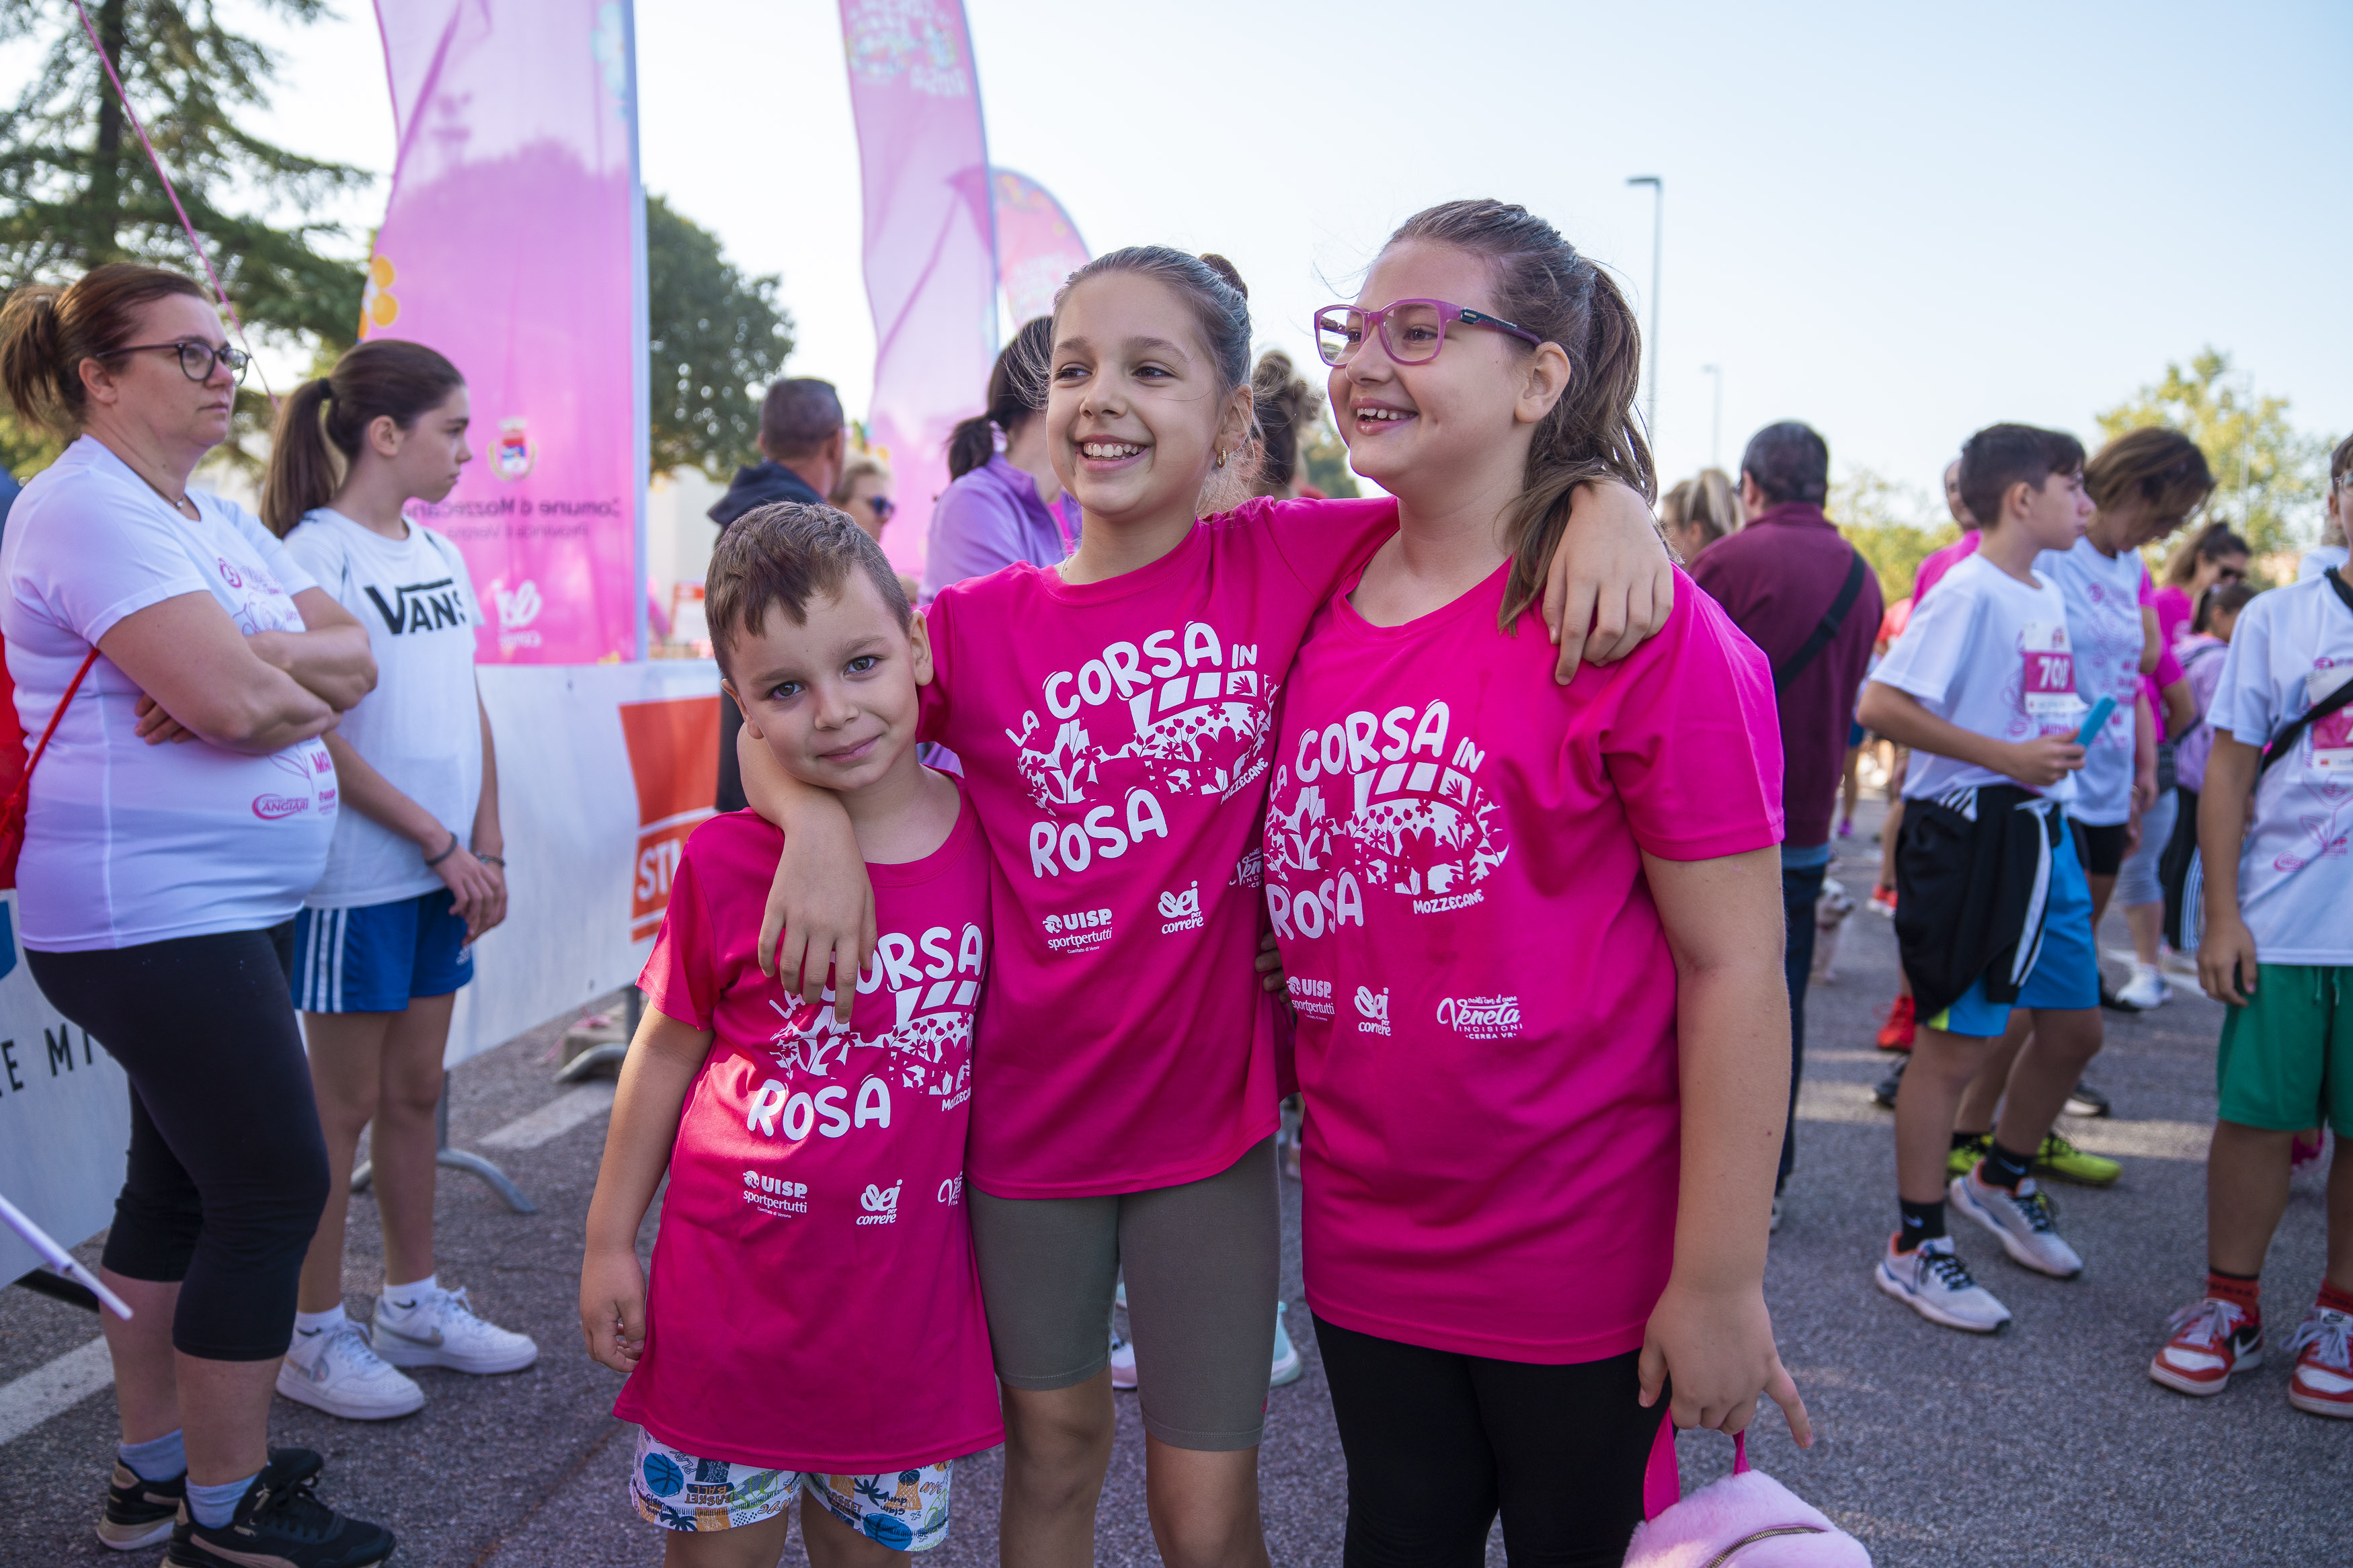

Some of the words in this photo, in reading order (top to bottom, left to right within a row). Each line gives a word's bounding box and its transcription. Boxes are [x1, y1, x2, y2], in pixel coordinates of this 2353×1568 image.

[1006, 710, 1040, 747] LA
[1043, 621, 1222, 719] CORSA
[1232, 644, 1257, 669] IN
[1270, 765, 1287, 802] LA
[1295, 700, 1449, 782] CORSA
[1452, 737, 1485, 773] IN
[1221, 757, 1269, 804] MOZZECANE
[1029, 787, 1168, 878] ROSA
[1266, 868, 1364, 940] ROSA
[1413, 889, 1484, 914] MOZZECANE
[1063, 909, 1113, 930] UISP
[1162, 916, 1204, 934] correre
[1048, 927, 1113, 951] sportpertutti
[1302, 979, 1332, 999] UISP
[1291, 999, 1335, 1016] sportpertutti
[1437, 997, 1521, 1032] Veneta
[1358, 1022, 1392, 1036] correre
[1459, 1024, 1523, 1032] INCISIONI
[0, 1039, 24, 1098] E
[747, 1075, 891, 1141] ROSA
[761, 1175, 807, 1198] UISP
[743, 1190, 807, 1213] sportpertutti
[856, 1214, 897, 1225] correre
[694, 1485, 727, 1494] BALL
